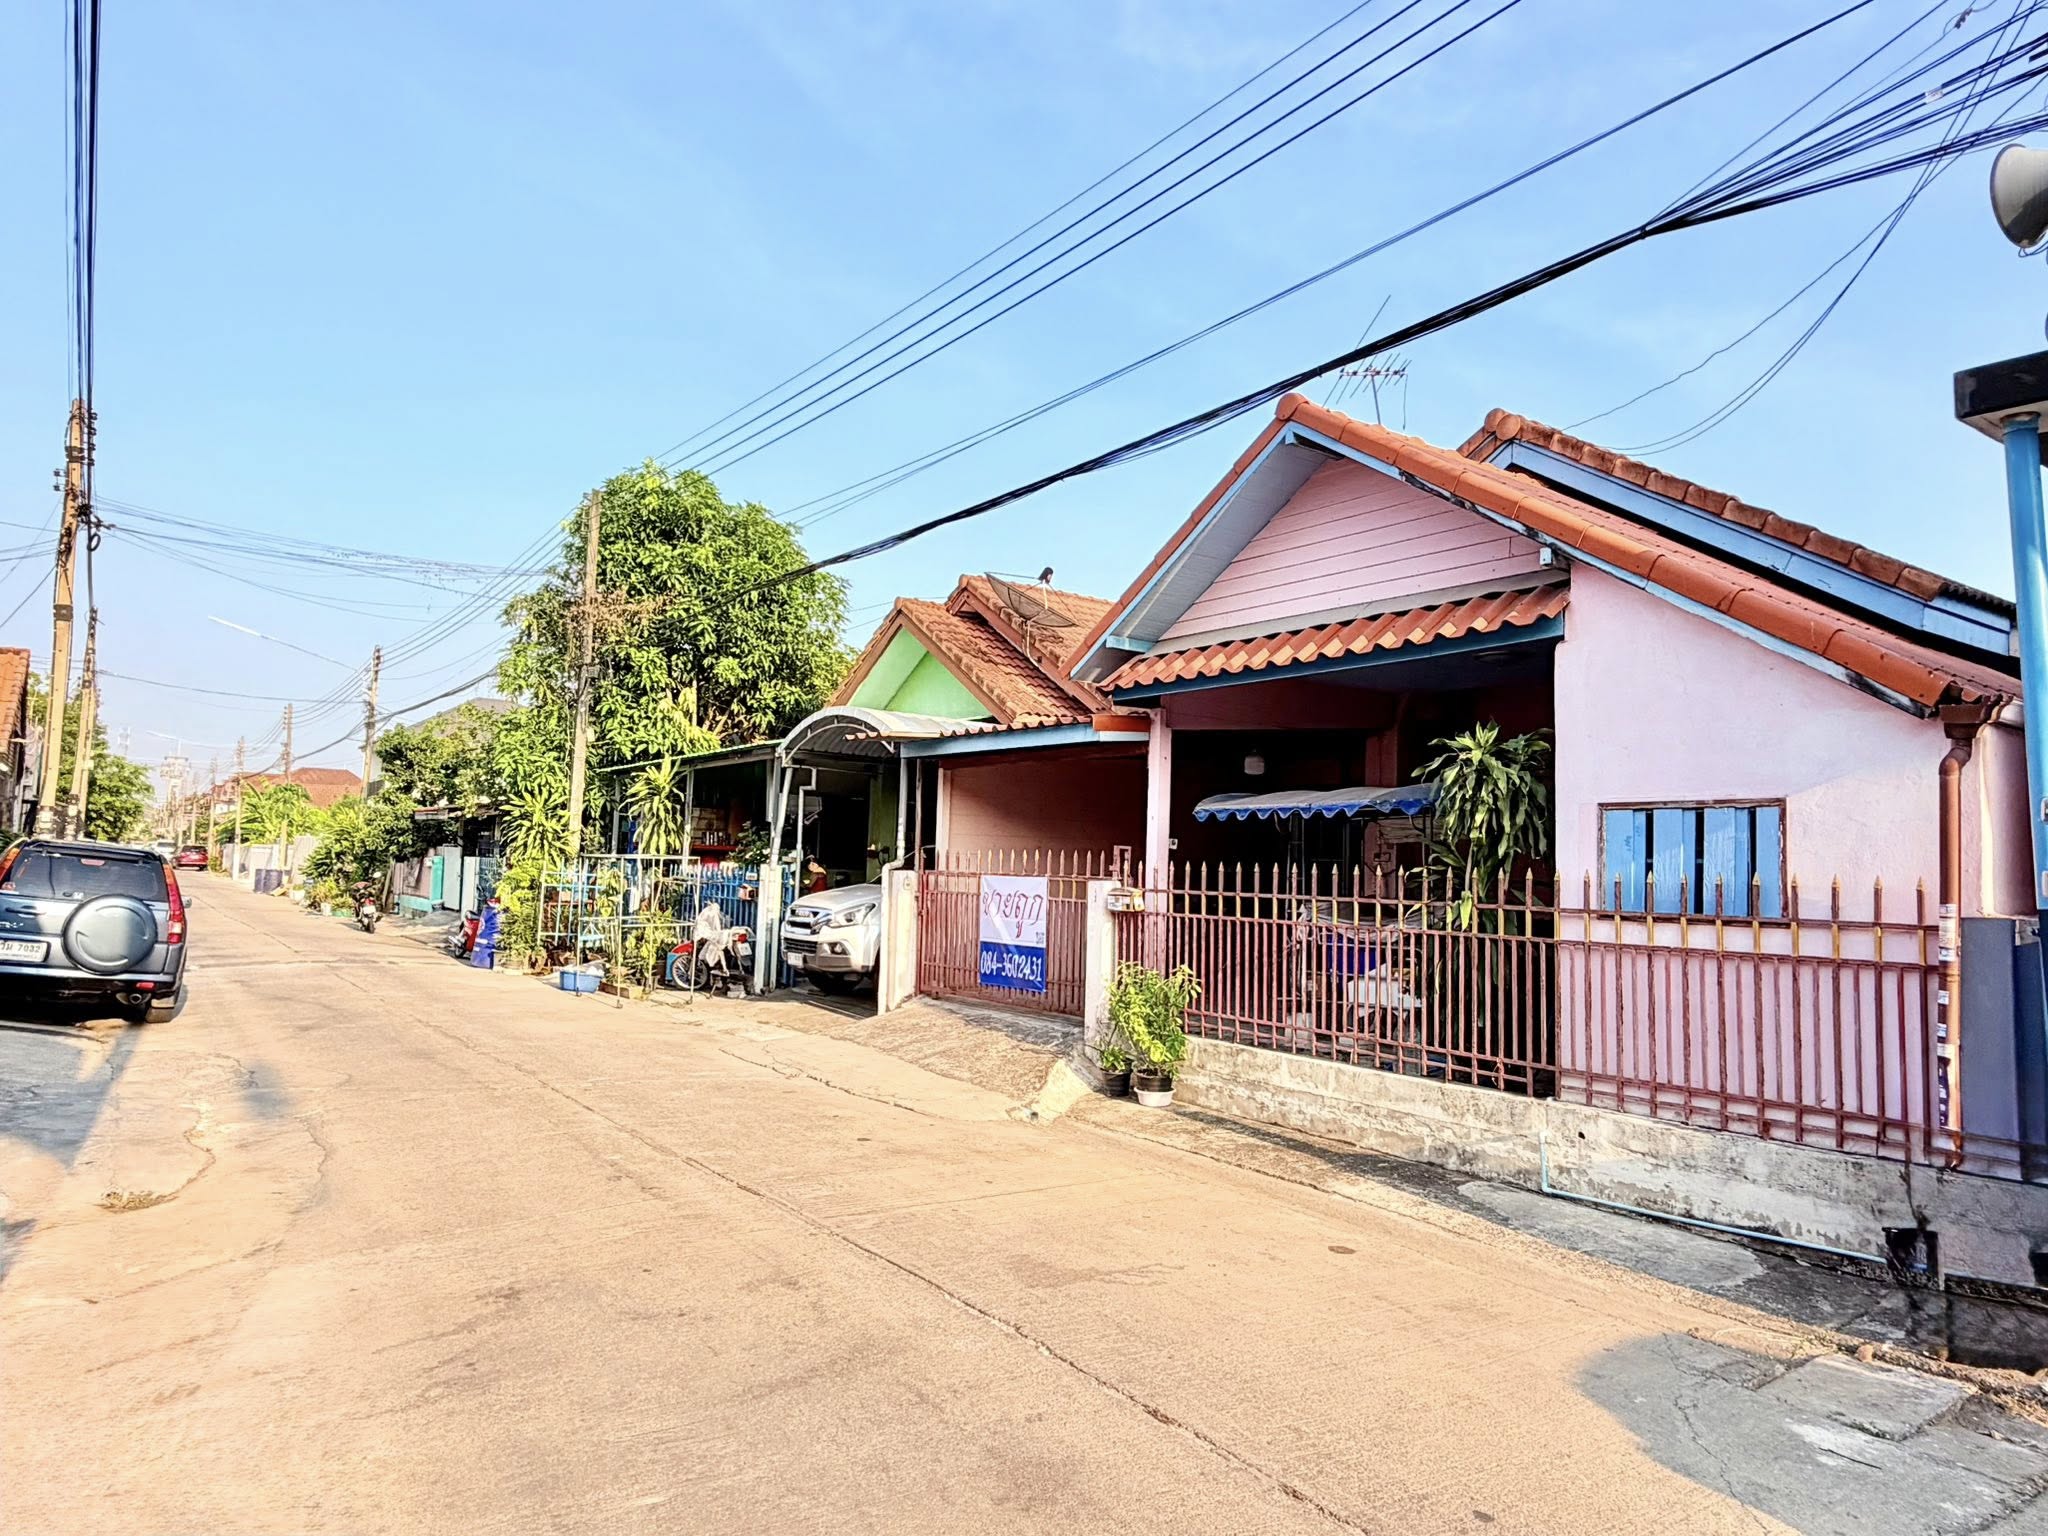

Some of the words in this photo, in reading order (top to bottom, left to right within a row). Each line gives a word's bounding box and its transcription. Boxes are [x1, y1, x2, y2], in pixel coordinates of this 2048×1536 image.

[982, 889, 1044, 939] ขายถูก
[980, 950, 1043, 981] 084-3602431
